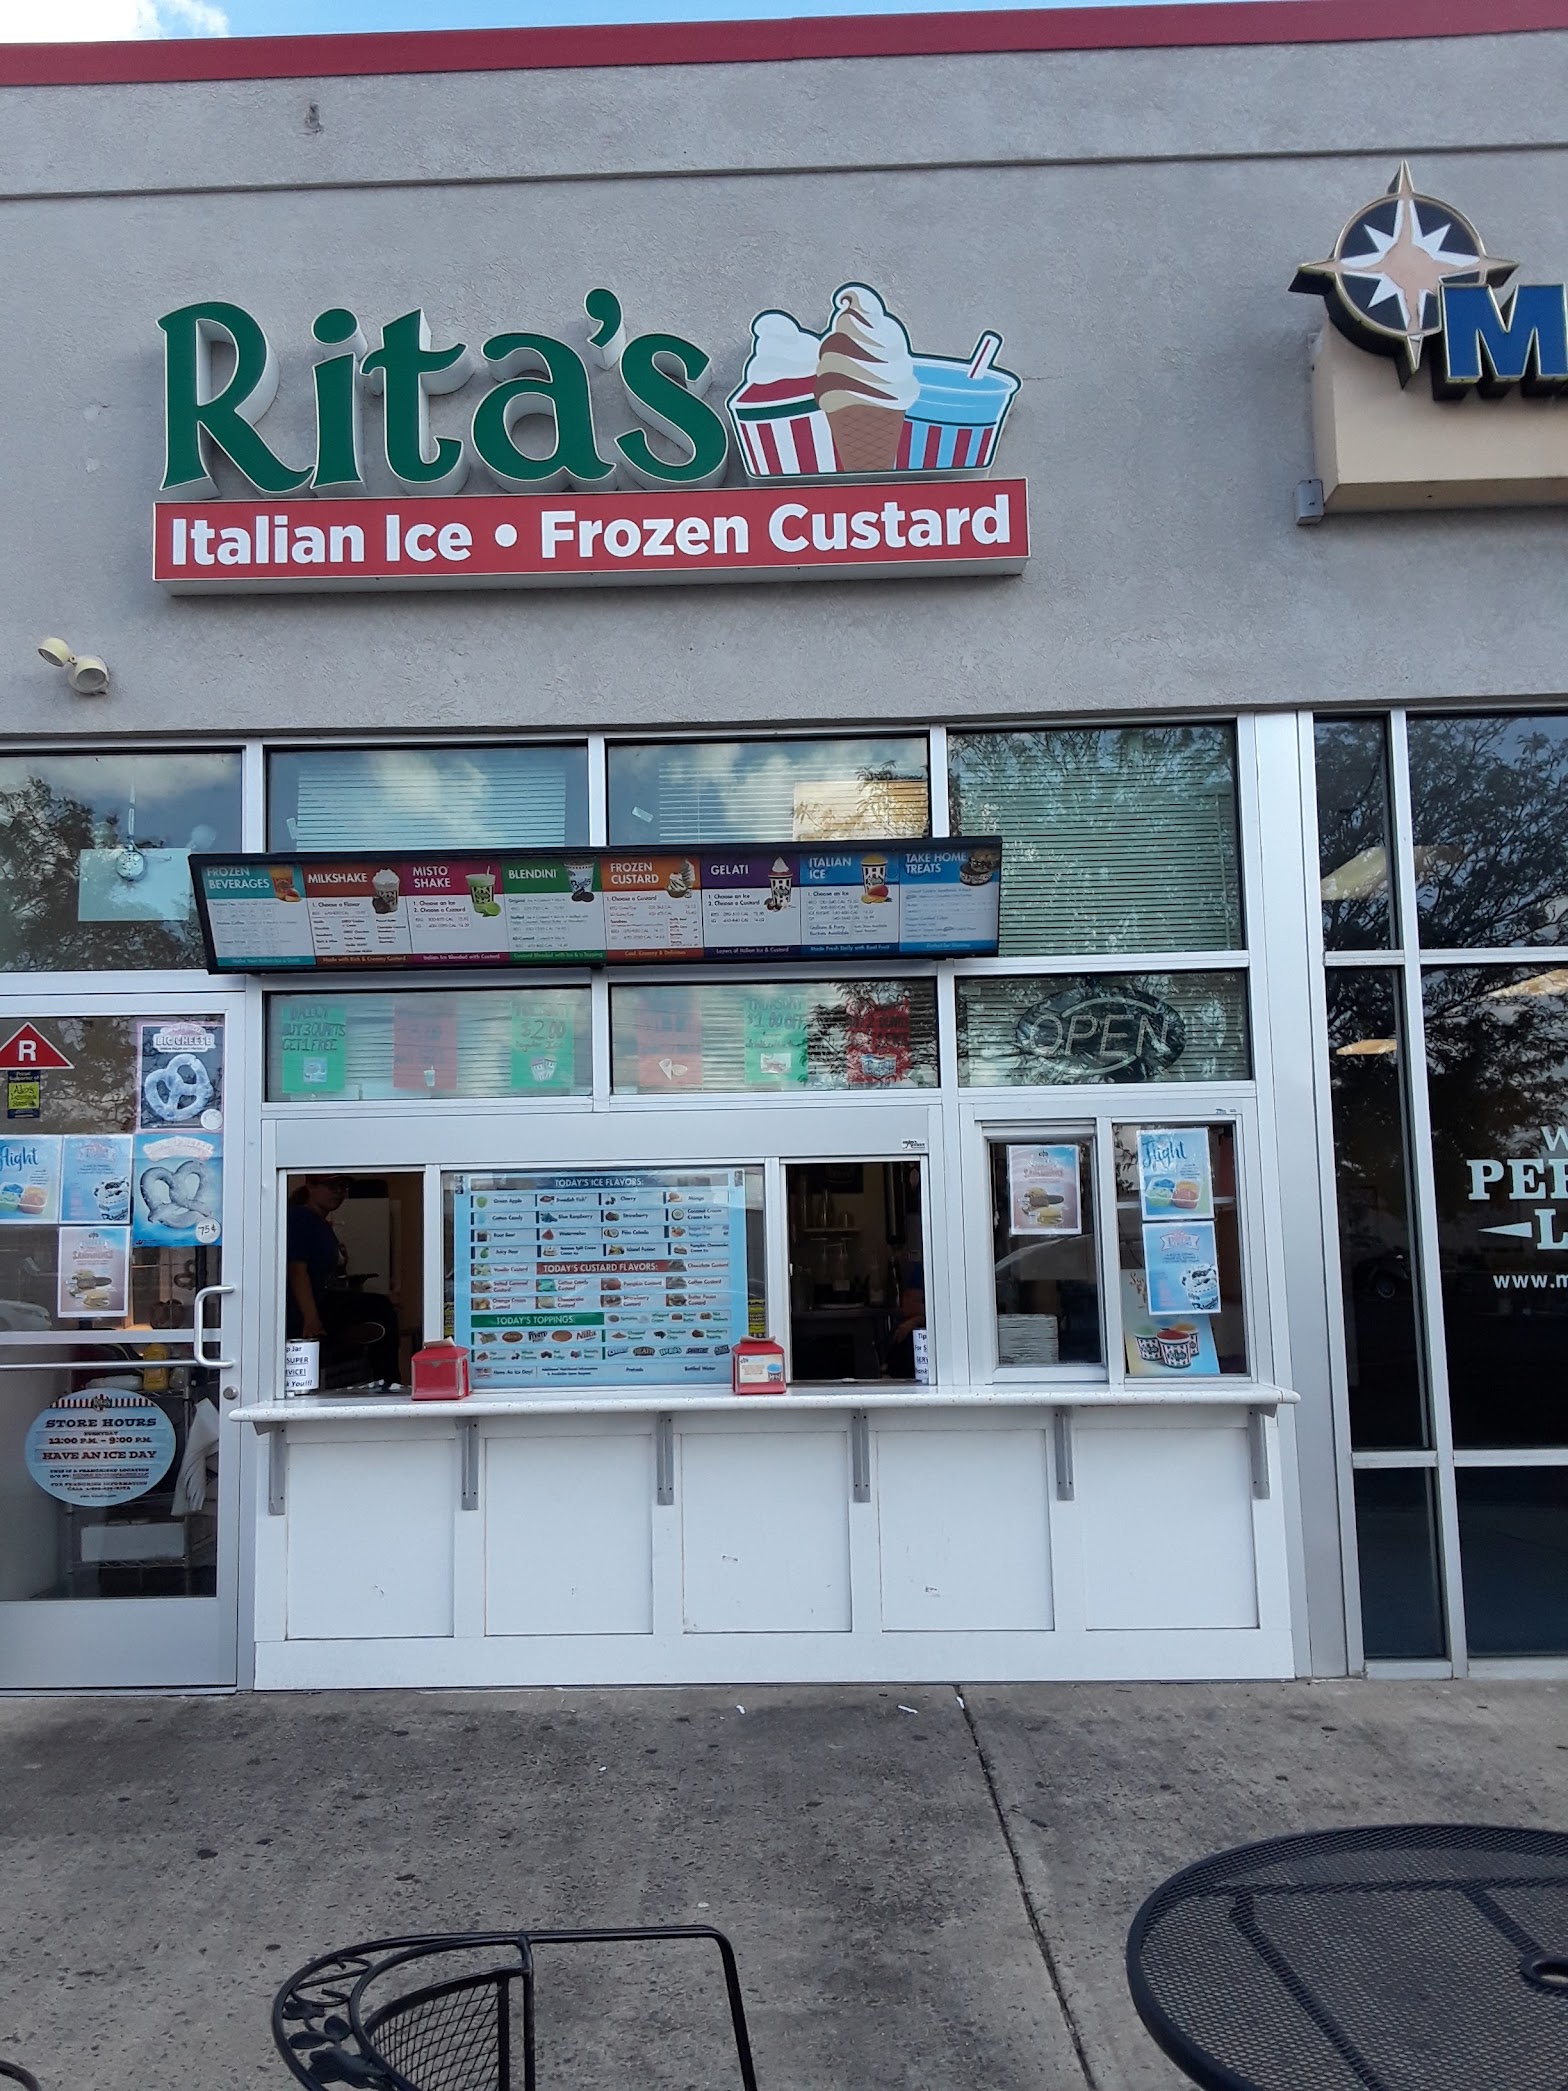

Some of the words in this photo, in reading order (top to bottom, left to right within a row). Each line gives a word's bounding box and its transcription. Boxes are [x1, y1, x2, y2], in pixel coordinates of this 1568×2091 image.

[155, 287, 729, 494] Rita's
[171, 514, 365, 565] Italian
[386, 513, 473, 563] Ice
[541, 510, 749, 559] Frozen
[768, 494, 1011, 552] Custard
[808, 857, 852, 868] ITALIAN
[905, 853, 931, 863] TAKE
[934, 852, 967, 862] HOME
[207, 866, 250, 878] FROZEN
[412, 866, 448, 877] MISTO
[610, 862, 653, 873] FROZEN
[710, 864, 749, 876] GELATI
[905, 863, 942, 874] TREATS
[308, 873, 368, 884] MILKSHAKE
[508, 869, 557, 879] BLENDINI
[611, 873, 660, 885] CUSTARD
[809, 869, 826, 880] ICE
[209, 878, 270, 890] BEVERAGES
[414, 878, 452, 888] SHAKE
[174, 1036, 212, 1046] CHEESE
[1029, 1014, 1171, 1057] OPEN
[18, 1039, 37, 1062] R
[555, 1179, 589, 1187] TODAY'S
[605, 1178, 644, 1186] FLAVORS:
[543, 1264, 579, 1273] TODAY'S
[580, 1264, 617, 1272] CUSTARD
[619, 1263, 659, 1272] FLAVORS:
[496, 1316, 531, 1325] TODAY'S
[45, 1419, 98, 1428] STORE
[102, 1417, 157, 1427] HOURS
[109, 1436, 133, 1444] 9:00
[42, 1452, 79, 1460] HAVE
[81, 1451, 100, 1460] AN
[103, 1451, 127, 1459] ICE
[129, 1450, 157, 1459] DAY
